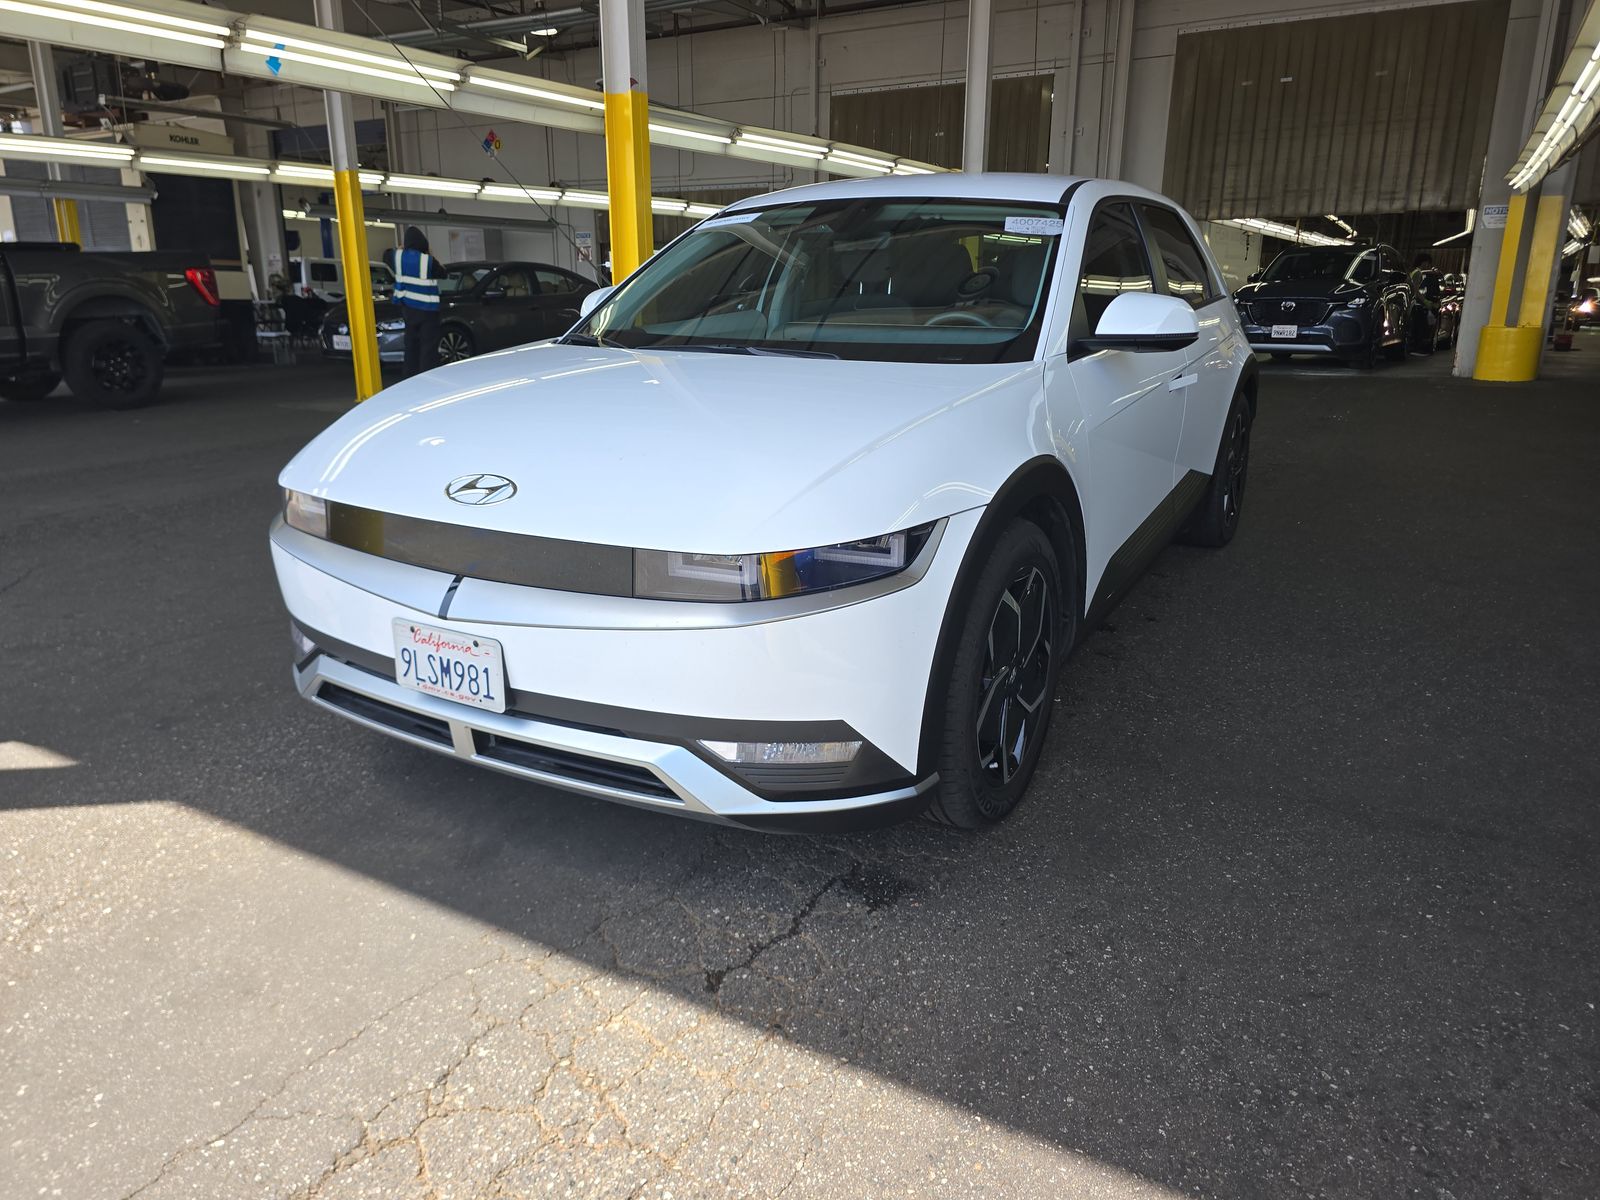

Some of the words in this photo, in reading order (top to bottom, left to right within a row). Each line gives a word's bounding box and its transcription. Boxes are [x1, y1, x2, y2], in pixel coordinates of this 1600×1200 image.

[168, 134, 200, 145] KOHLER
[413, 628, 480, 657] California
[401, 647, 495, 700] 9LSM981
